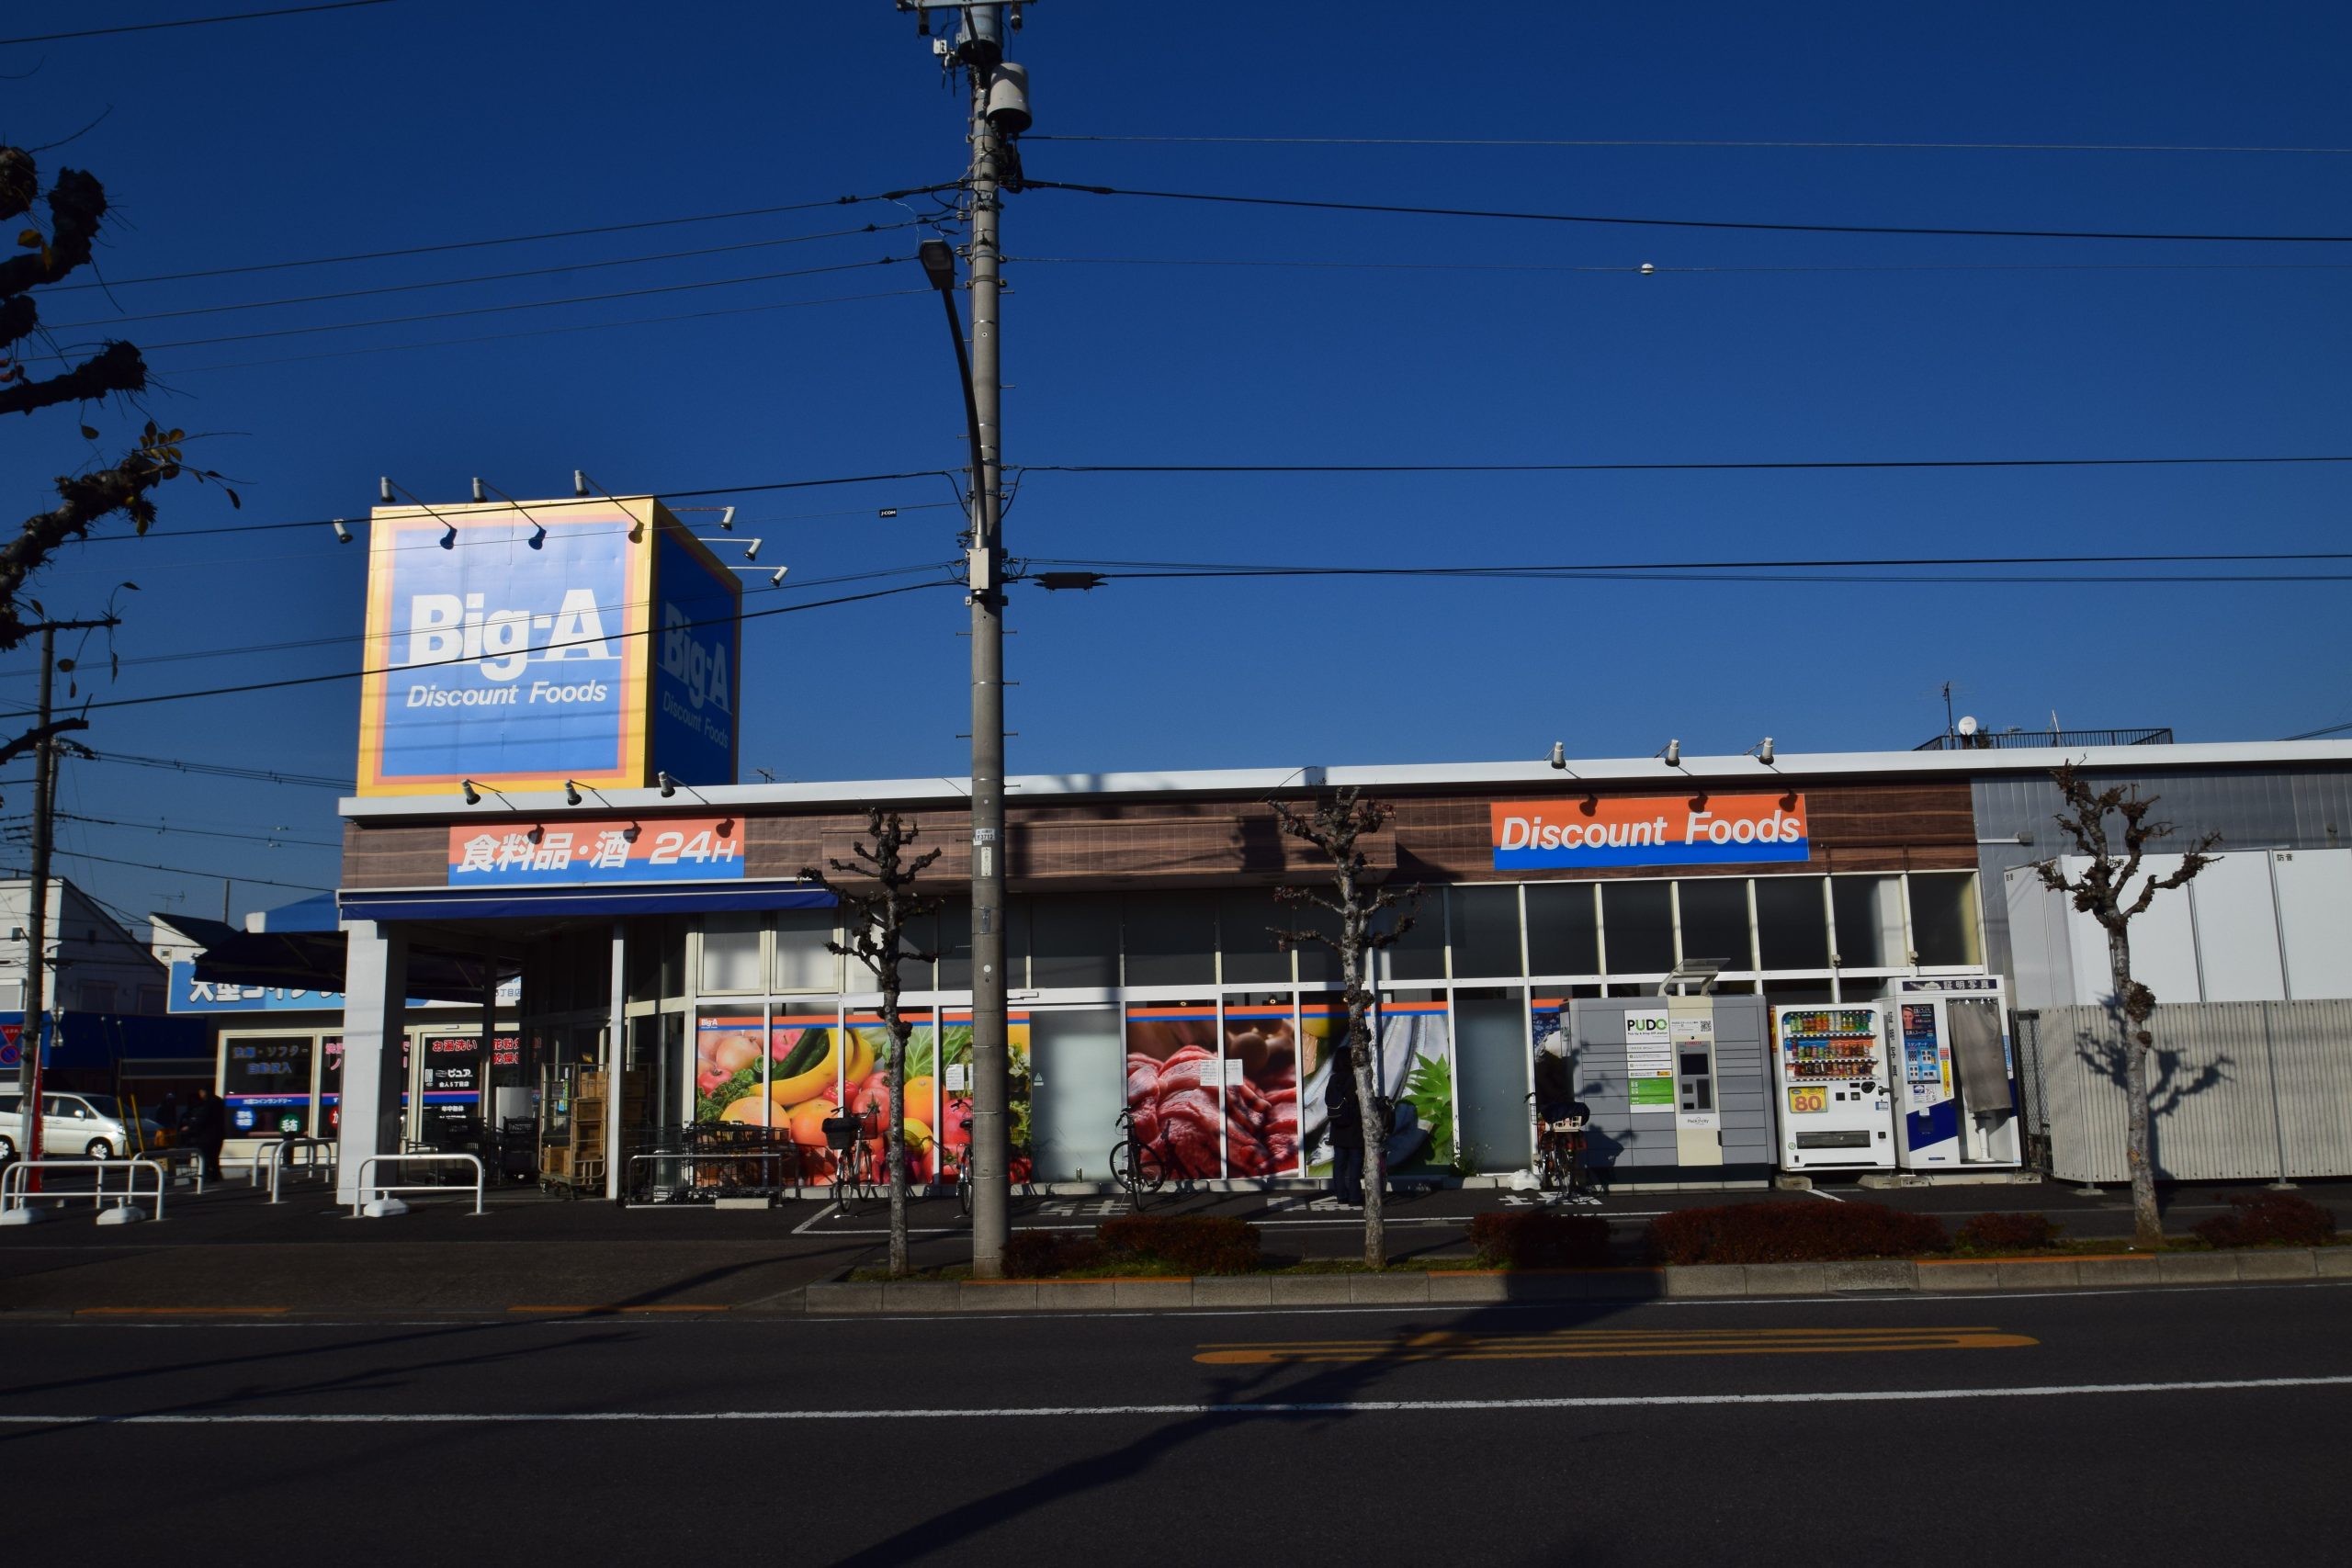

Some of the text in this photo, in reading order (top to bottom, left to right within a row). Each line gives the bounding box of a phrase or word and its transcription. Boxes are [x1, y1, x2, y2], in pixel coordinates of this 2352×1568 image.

[408, 589, 610, 682] Big-A
[664, 600, 729, 711] Big-A
[407, 679, 608, 708] Discount Foods
[662, 690, 729, 750] Discount Foods
[1500, 809, 1801, 852] Discount Foods
[649, 829, 737, 866] 24H
[2276, 853, 2293, 862] 防音
[1943, 979, 1990, 990] 証明写真
[1627, 1019, 1668, 1031] PUDO
[433, 1040, 478, 1053] お湯洗い
[1794, 1095, 1822, 1111] 80
[281, 1118, 298, 1133] 毛布
